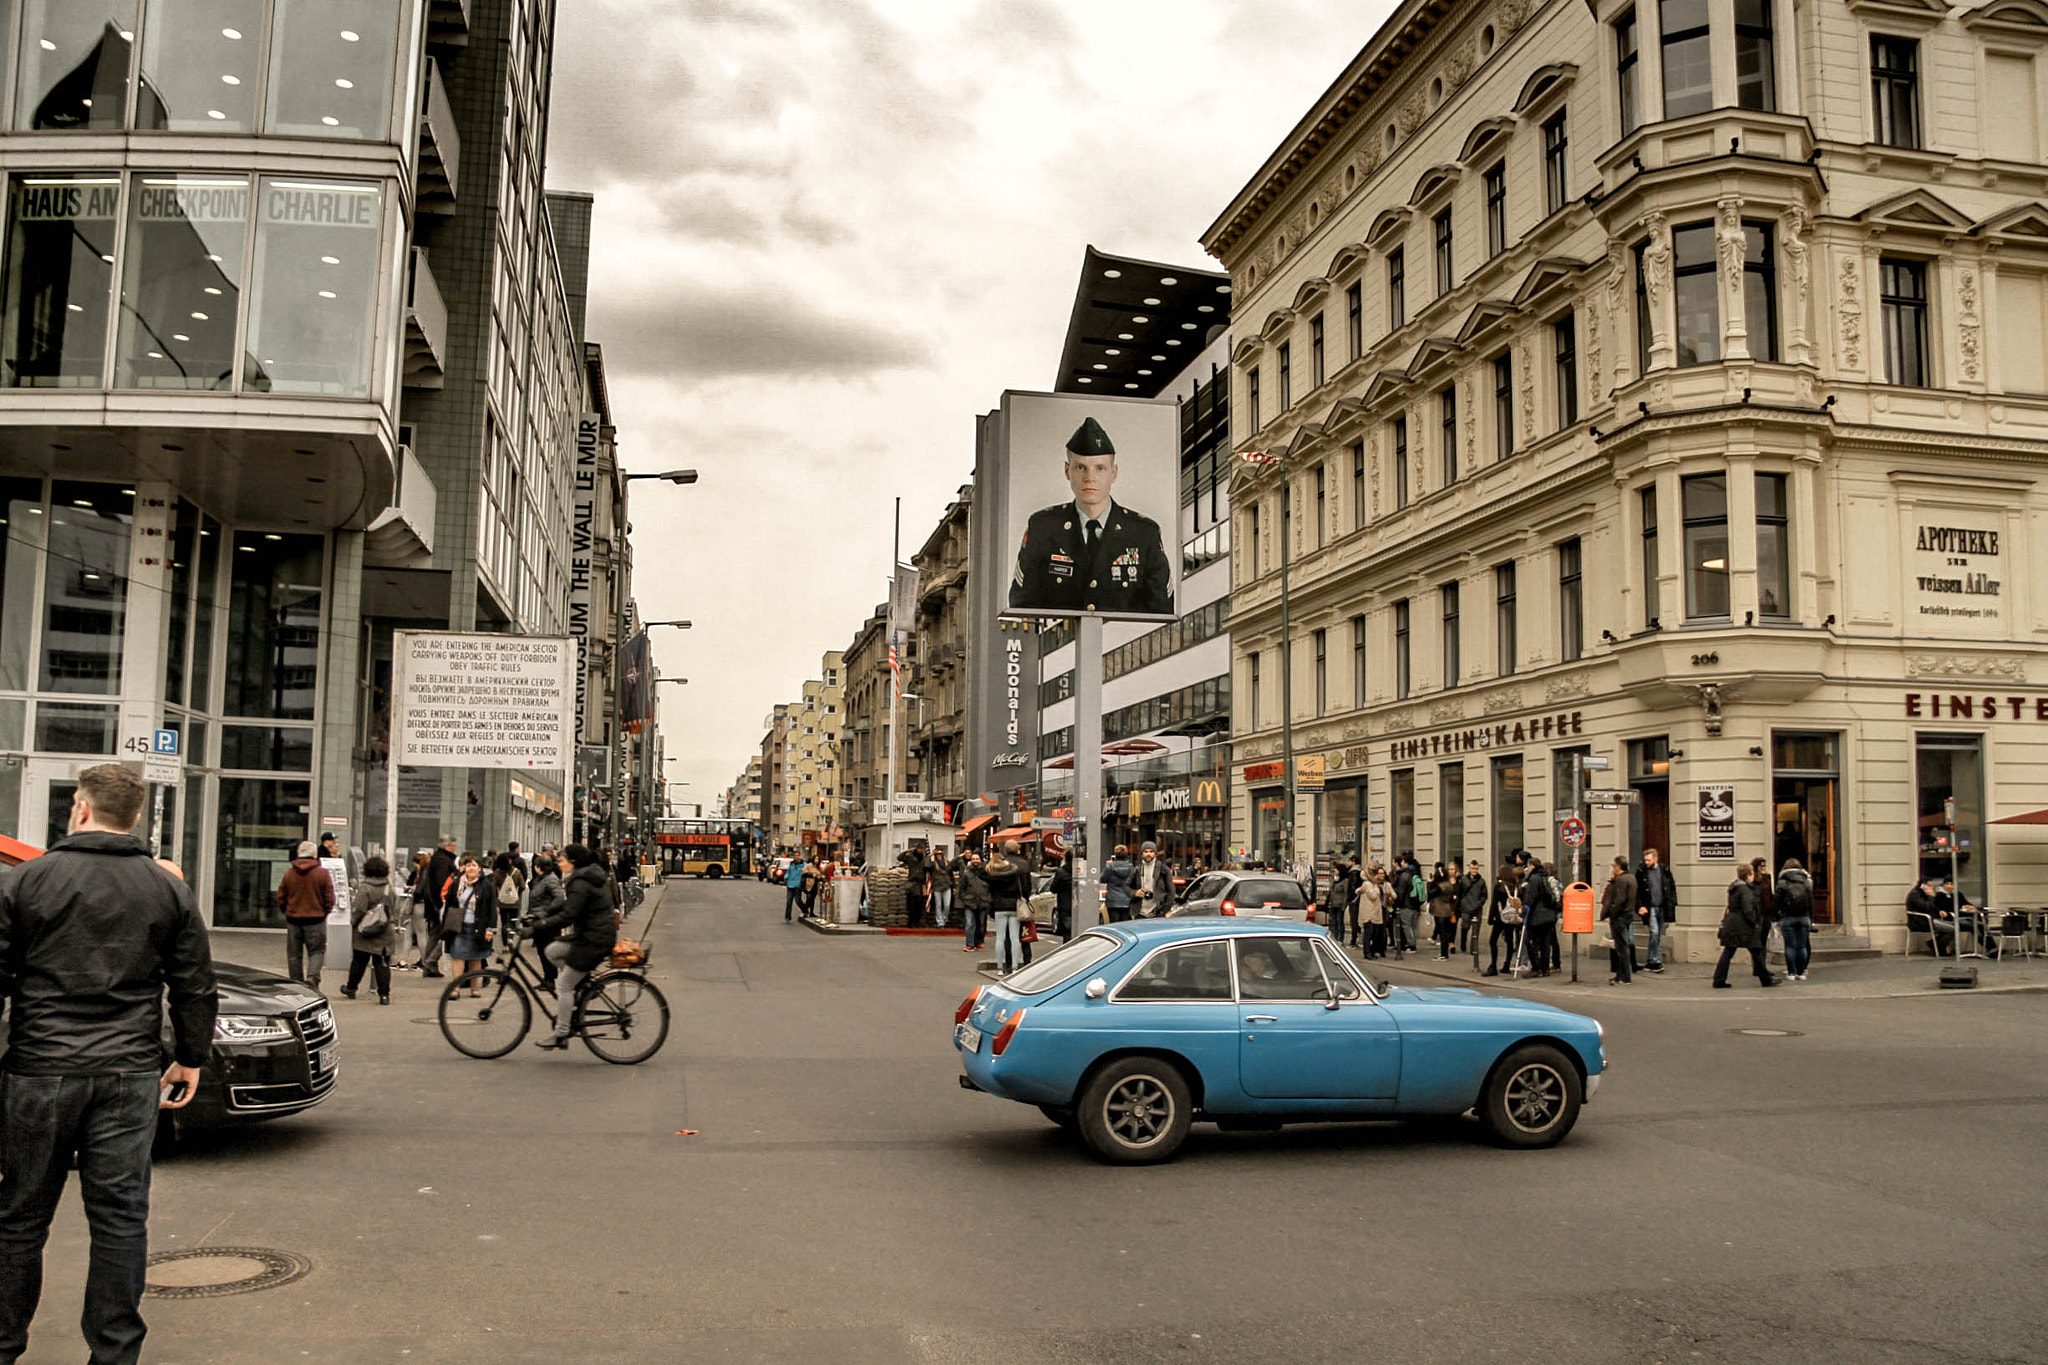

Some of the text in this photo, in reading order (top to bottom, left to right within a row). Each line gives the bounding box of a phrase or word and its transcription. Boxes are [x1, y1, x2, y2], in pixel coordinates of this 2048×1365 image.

[22, 187, 82, 218] HAUS
[139, 188, 248, 219] CHECKPOINT
[268, 190, 371, 225] CHARLIE
[578, 420, 597, 465] MUR
[576, 471, 594, 490] LE
[573, 501, 593, 553] WALL
[1916, 526, 1999, 556] APOTHEKE
[571, 557, 590, 592] THE
[1916, 572, 2000, 596] weissen Adler
[413, 639, 558, 653] YOU ARE ENTERING THE AMERICAN SECTOR
[412, 650, 557, 663] CARRYING WEAPONS OFF DUTY FORBIDDEN
[1690, 650, 1719, 666] 206
[450, 661, 521, 672] OBEY TRAFFIC RULES
[408, 708, 427, 718] VOUS
[430, 709, 455, 719] ENTREZ
[458, 710, 477, 719] DANS
[480, 711, 486, 719] LE
[489, 711, 519, 720] SECTEUR
[1906, 693, 2048, 720] EINSTE
[440, 720, 461, 729] PORTER
[462, 721, 473, 730] DES
[474, 721, 493, 730] ARMES
[494, 722, 502, 730] EN
[503, 722, 526, 731] DEHORS
[527, 723, 536, 731] DU
[536, 723, 559, 732] SERVICE
[452, 730, 467, 740] AUX
[497, 732, 505, 741] DE
[508, 732, 551, 742] CIRCULATION
[1390, 711, 1582, 761] EINSTEIN KAFFEE
[125, 737, 149, 753] 45
[407, 743, 558, 756] SIE BETRETEN DEN AMERIKANISCHEN SEKTOR
[692, 835, 720, 844] SCHULE
